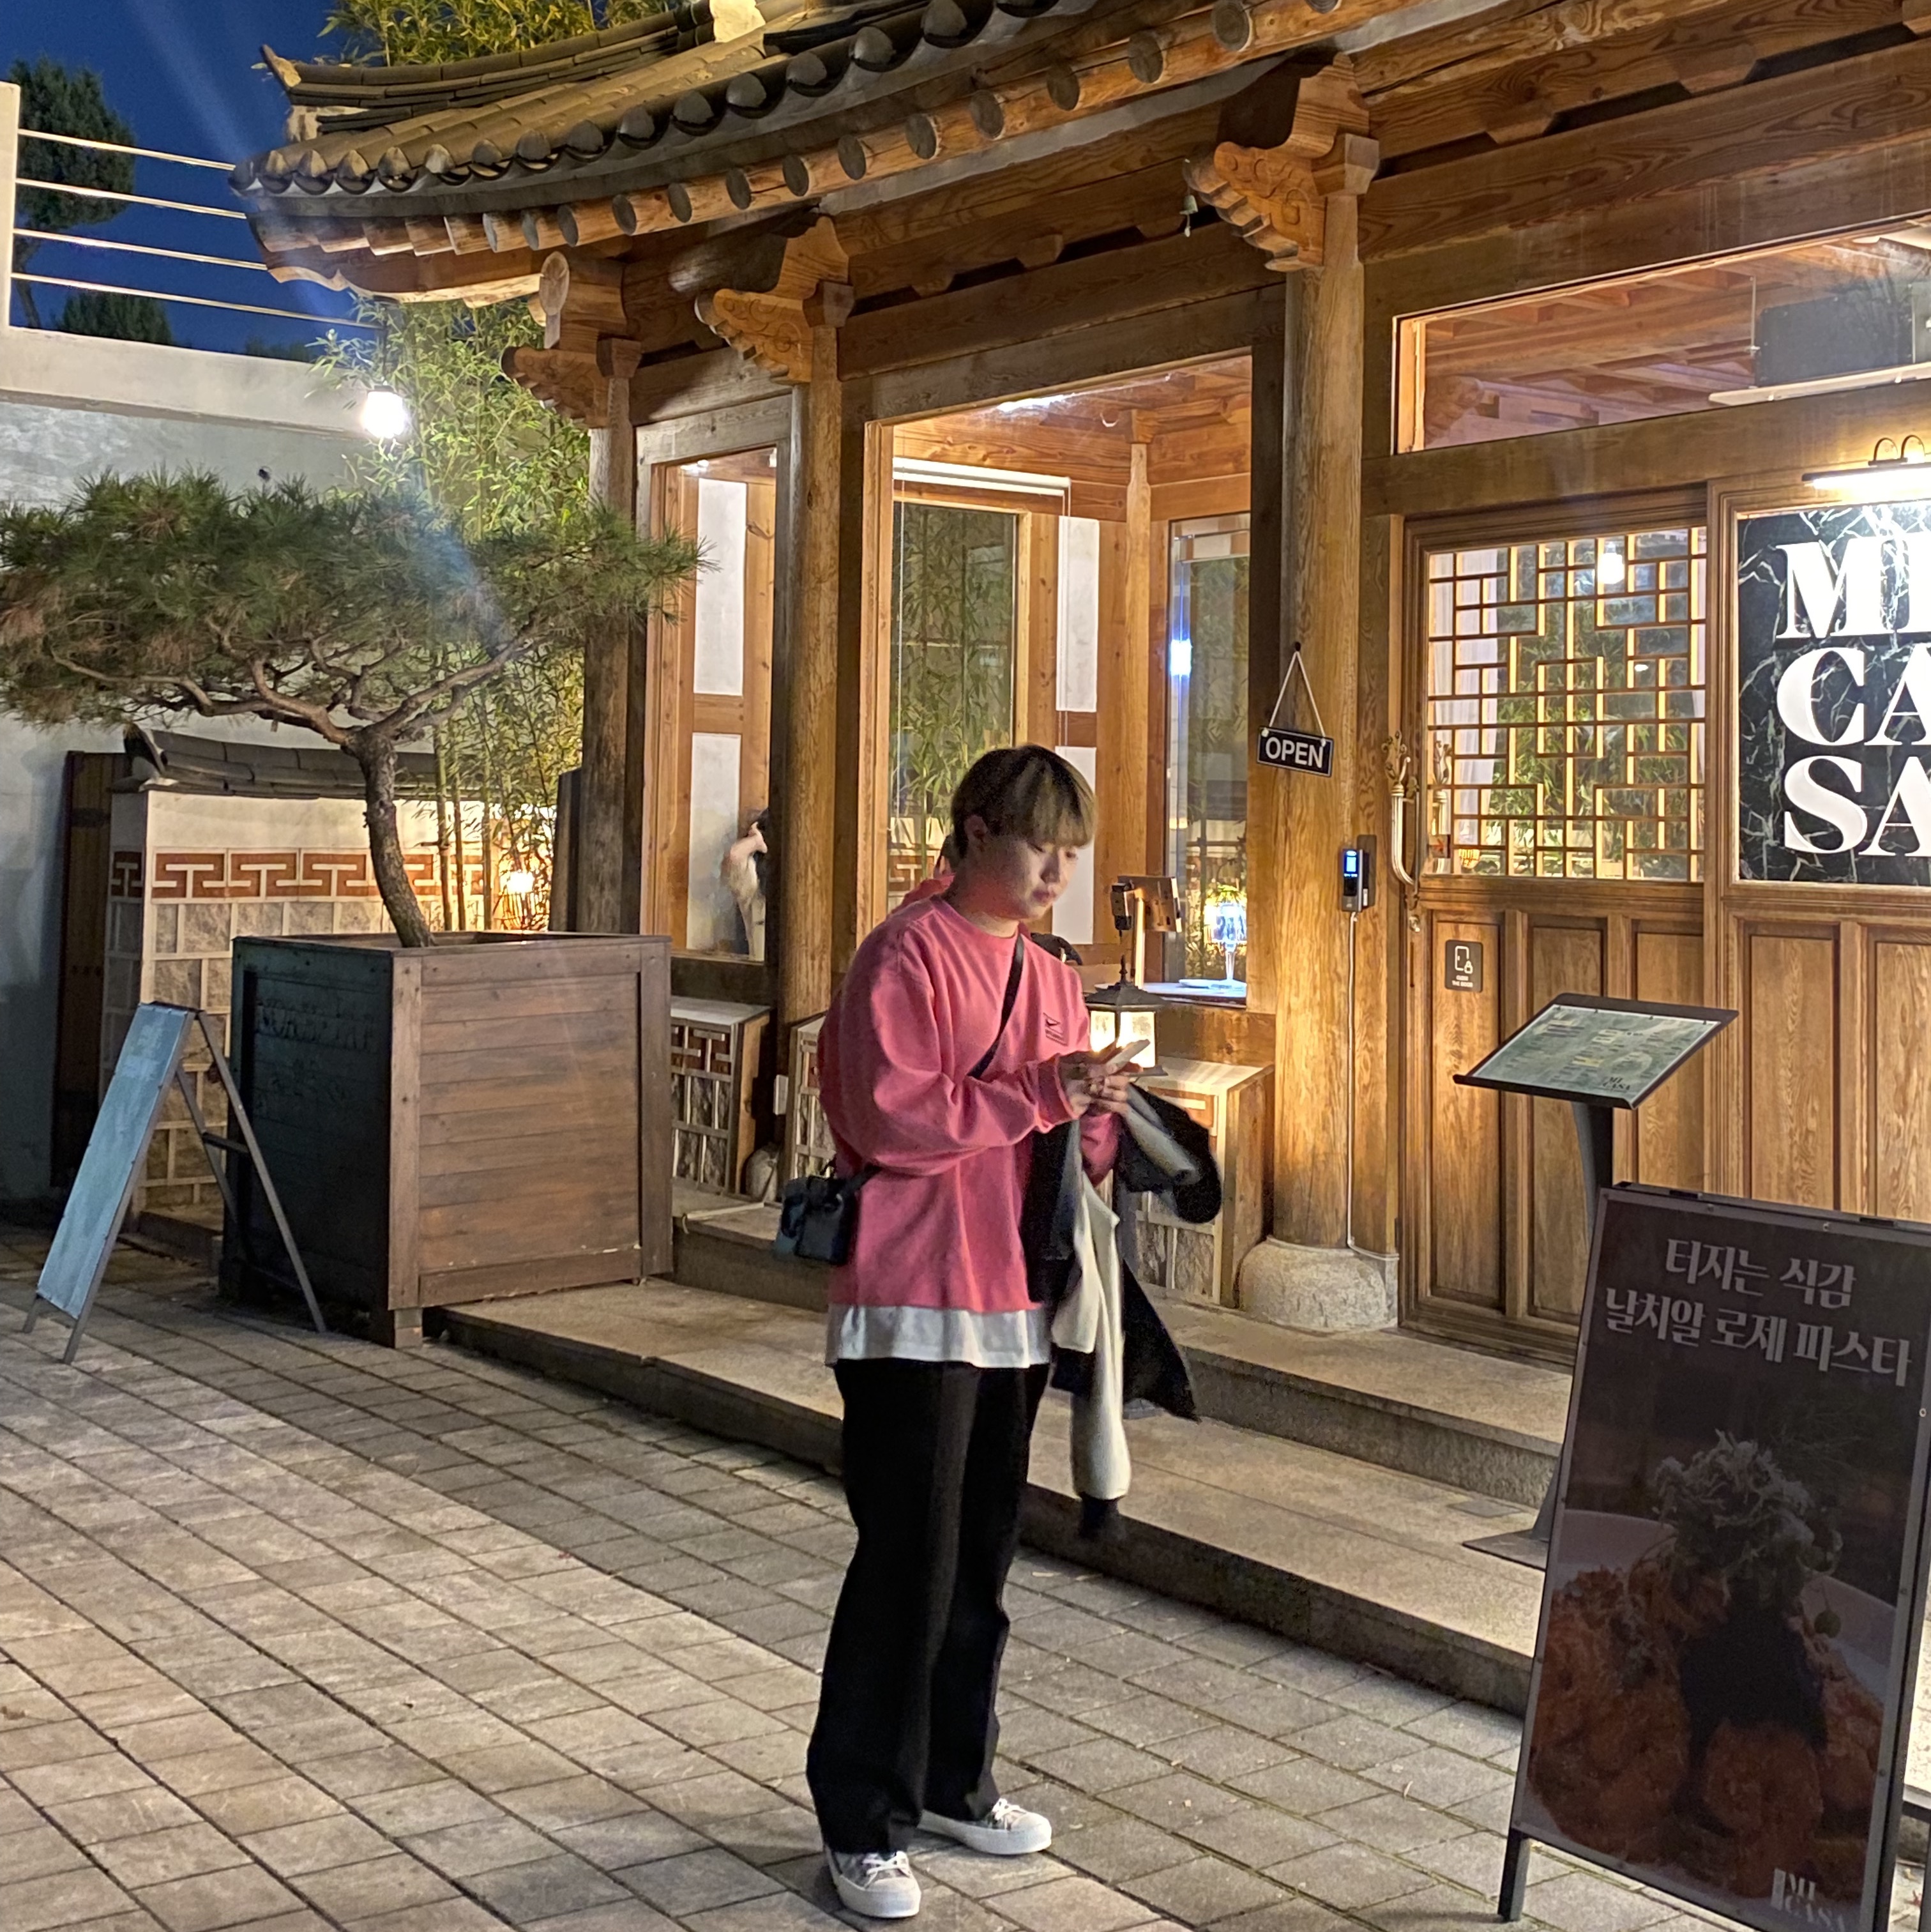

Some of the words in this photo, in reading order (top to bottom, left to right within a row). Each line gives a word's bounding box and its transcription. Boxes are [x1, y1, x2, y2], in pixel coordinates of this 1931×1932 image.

[1265, 736, 1324, 768] OPEN
[1665, 1238, 1770, 1297] 터지는
[1780, 1257, 1856, 1309] 식감
[1606, 1288, 1706, 1347] 날치알
[1711, 1308, 1787, 1364] 로제
[1793, 1322, 1912, 1387] 파스타
